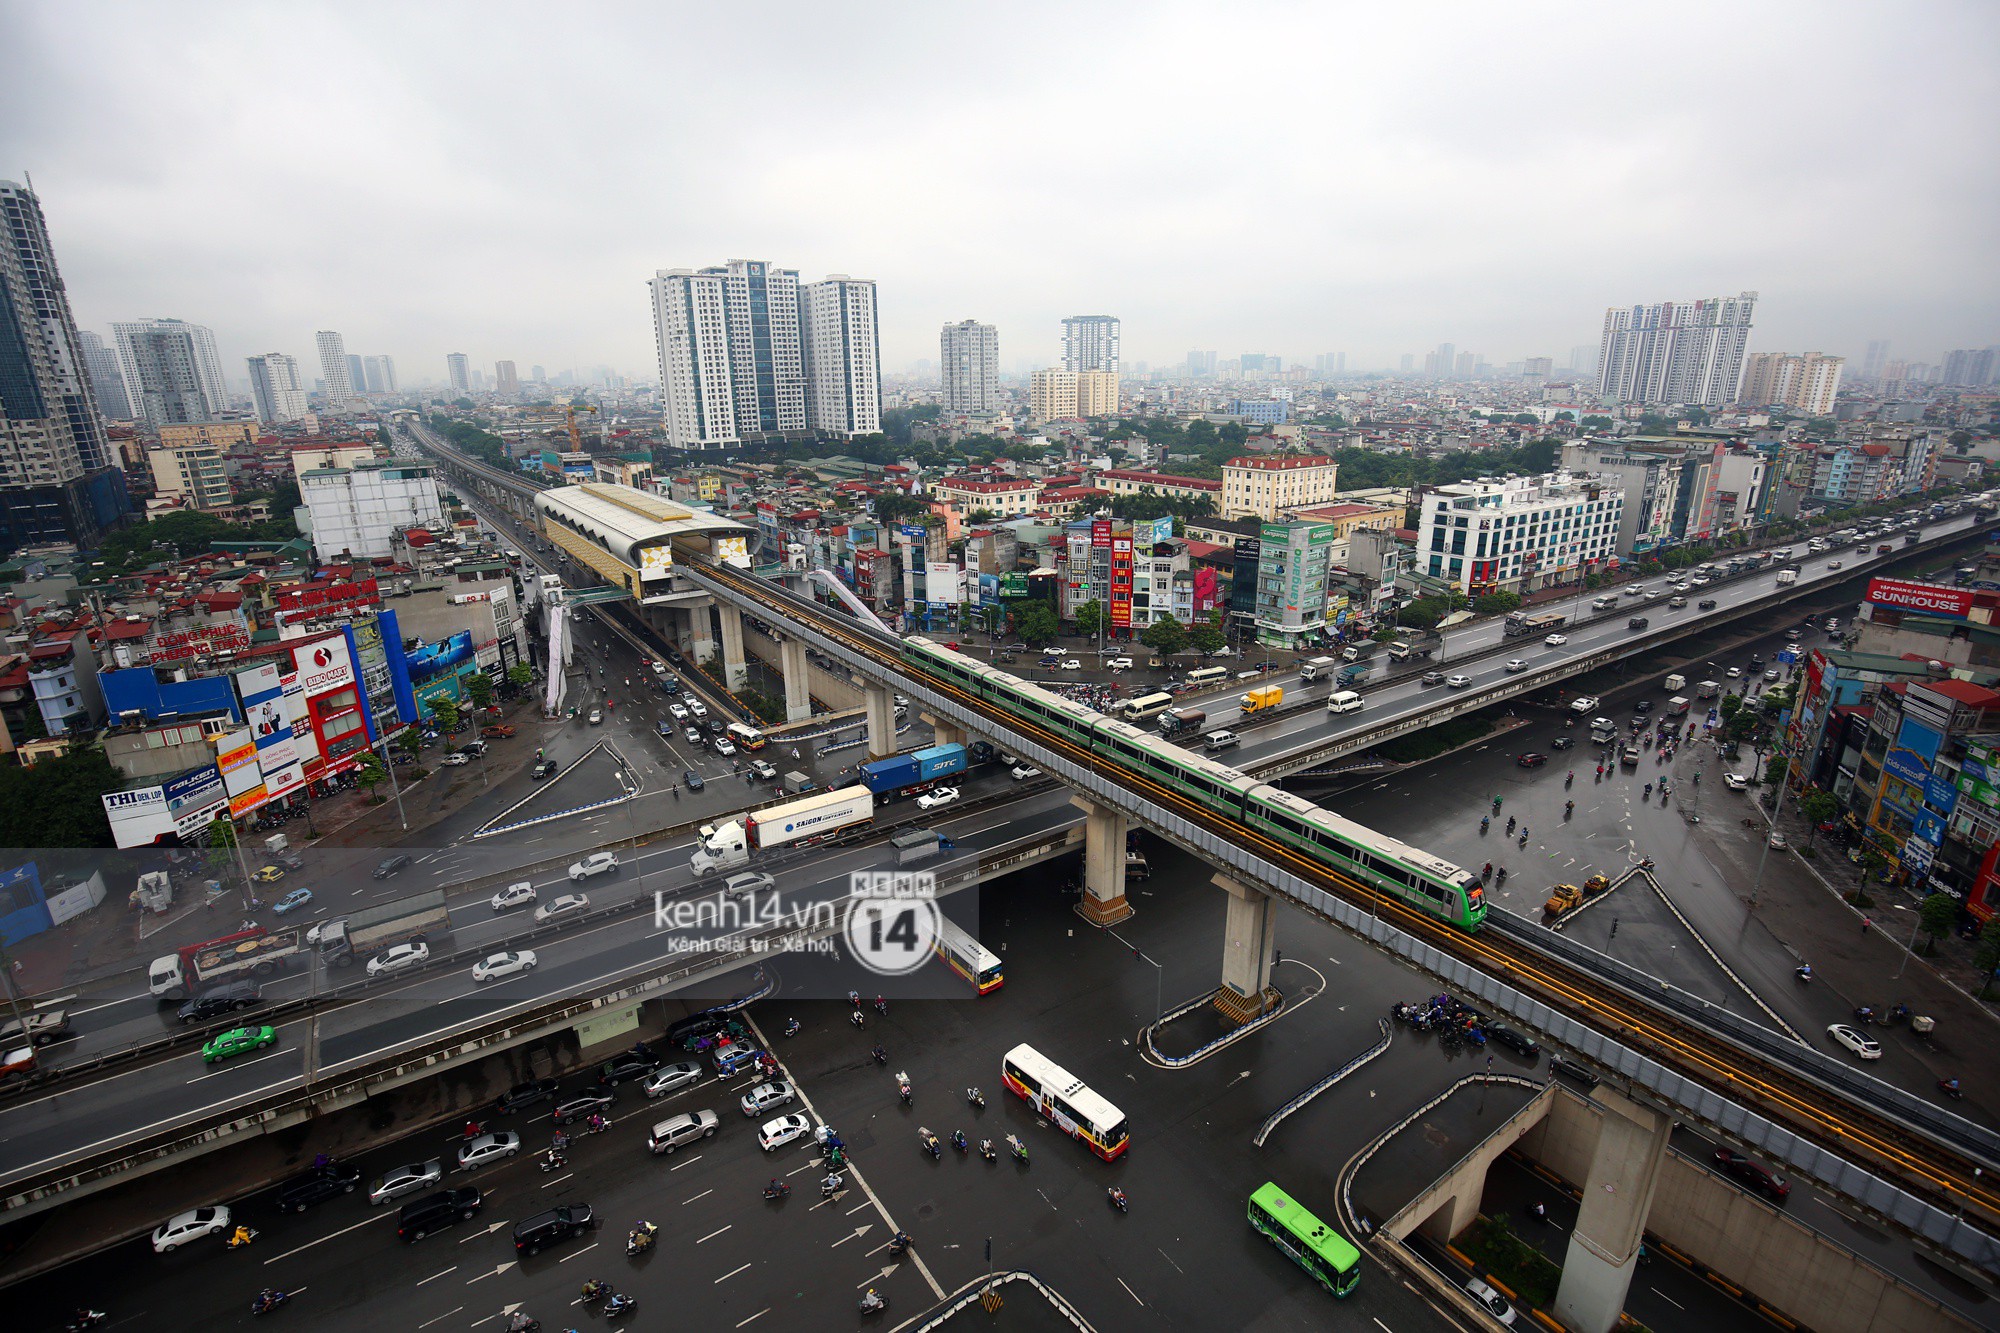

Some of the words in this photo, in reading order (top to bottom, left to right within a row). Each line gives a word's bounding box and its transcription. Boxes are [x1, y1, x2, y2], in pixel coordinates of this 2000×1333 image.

[1286, 548, 1302, 611] Kangaroo
[1871, 590, 1960, 612] SUNHOUSE
[306, 673, 326, 687] BIBO
[326, 666, 347, 681] MART
[932, 758, 957, 771] SITC
[1886, 756, 1901, 770] Kids
[1900, 763, 1919, 779] plaza
[169, 768, 216, 792] FALKEN
[106, 791, 138, 807] THI
